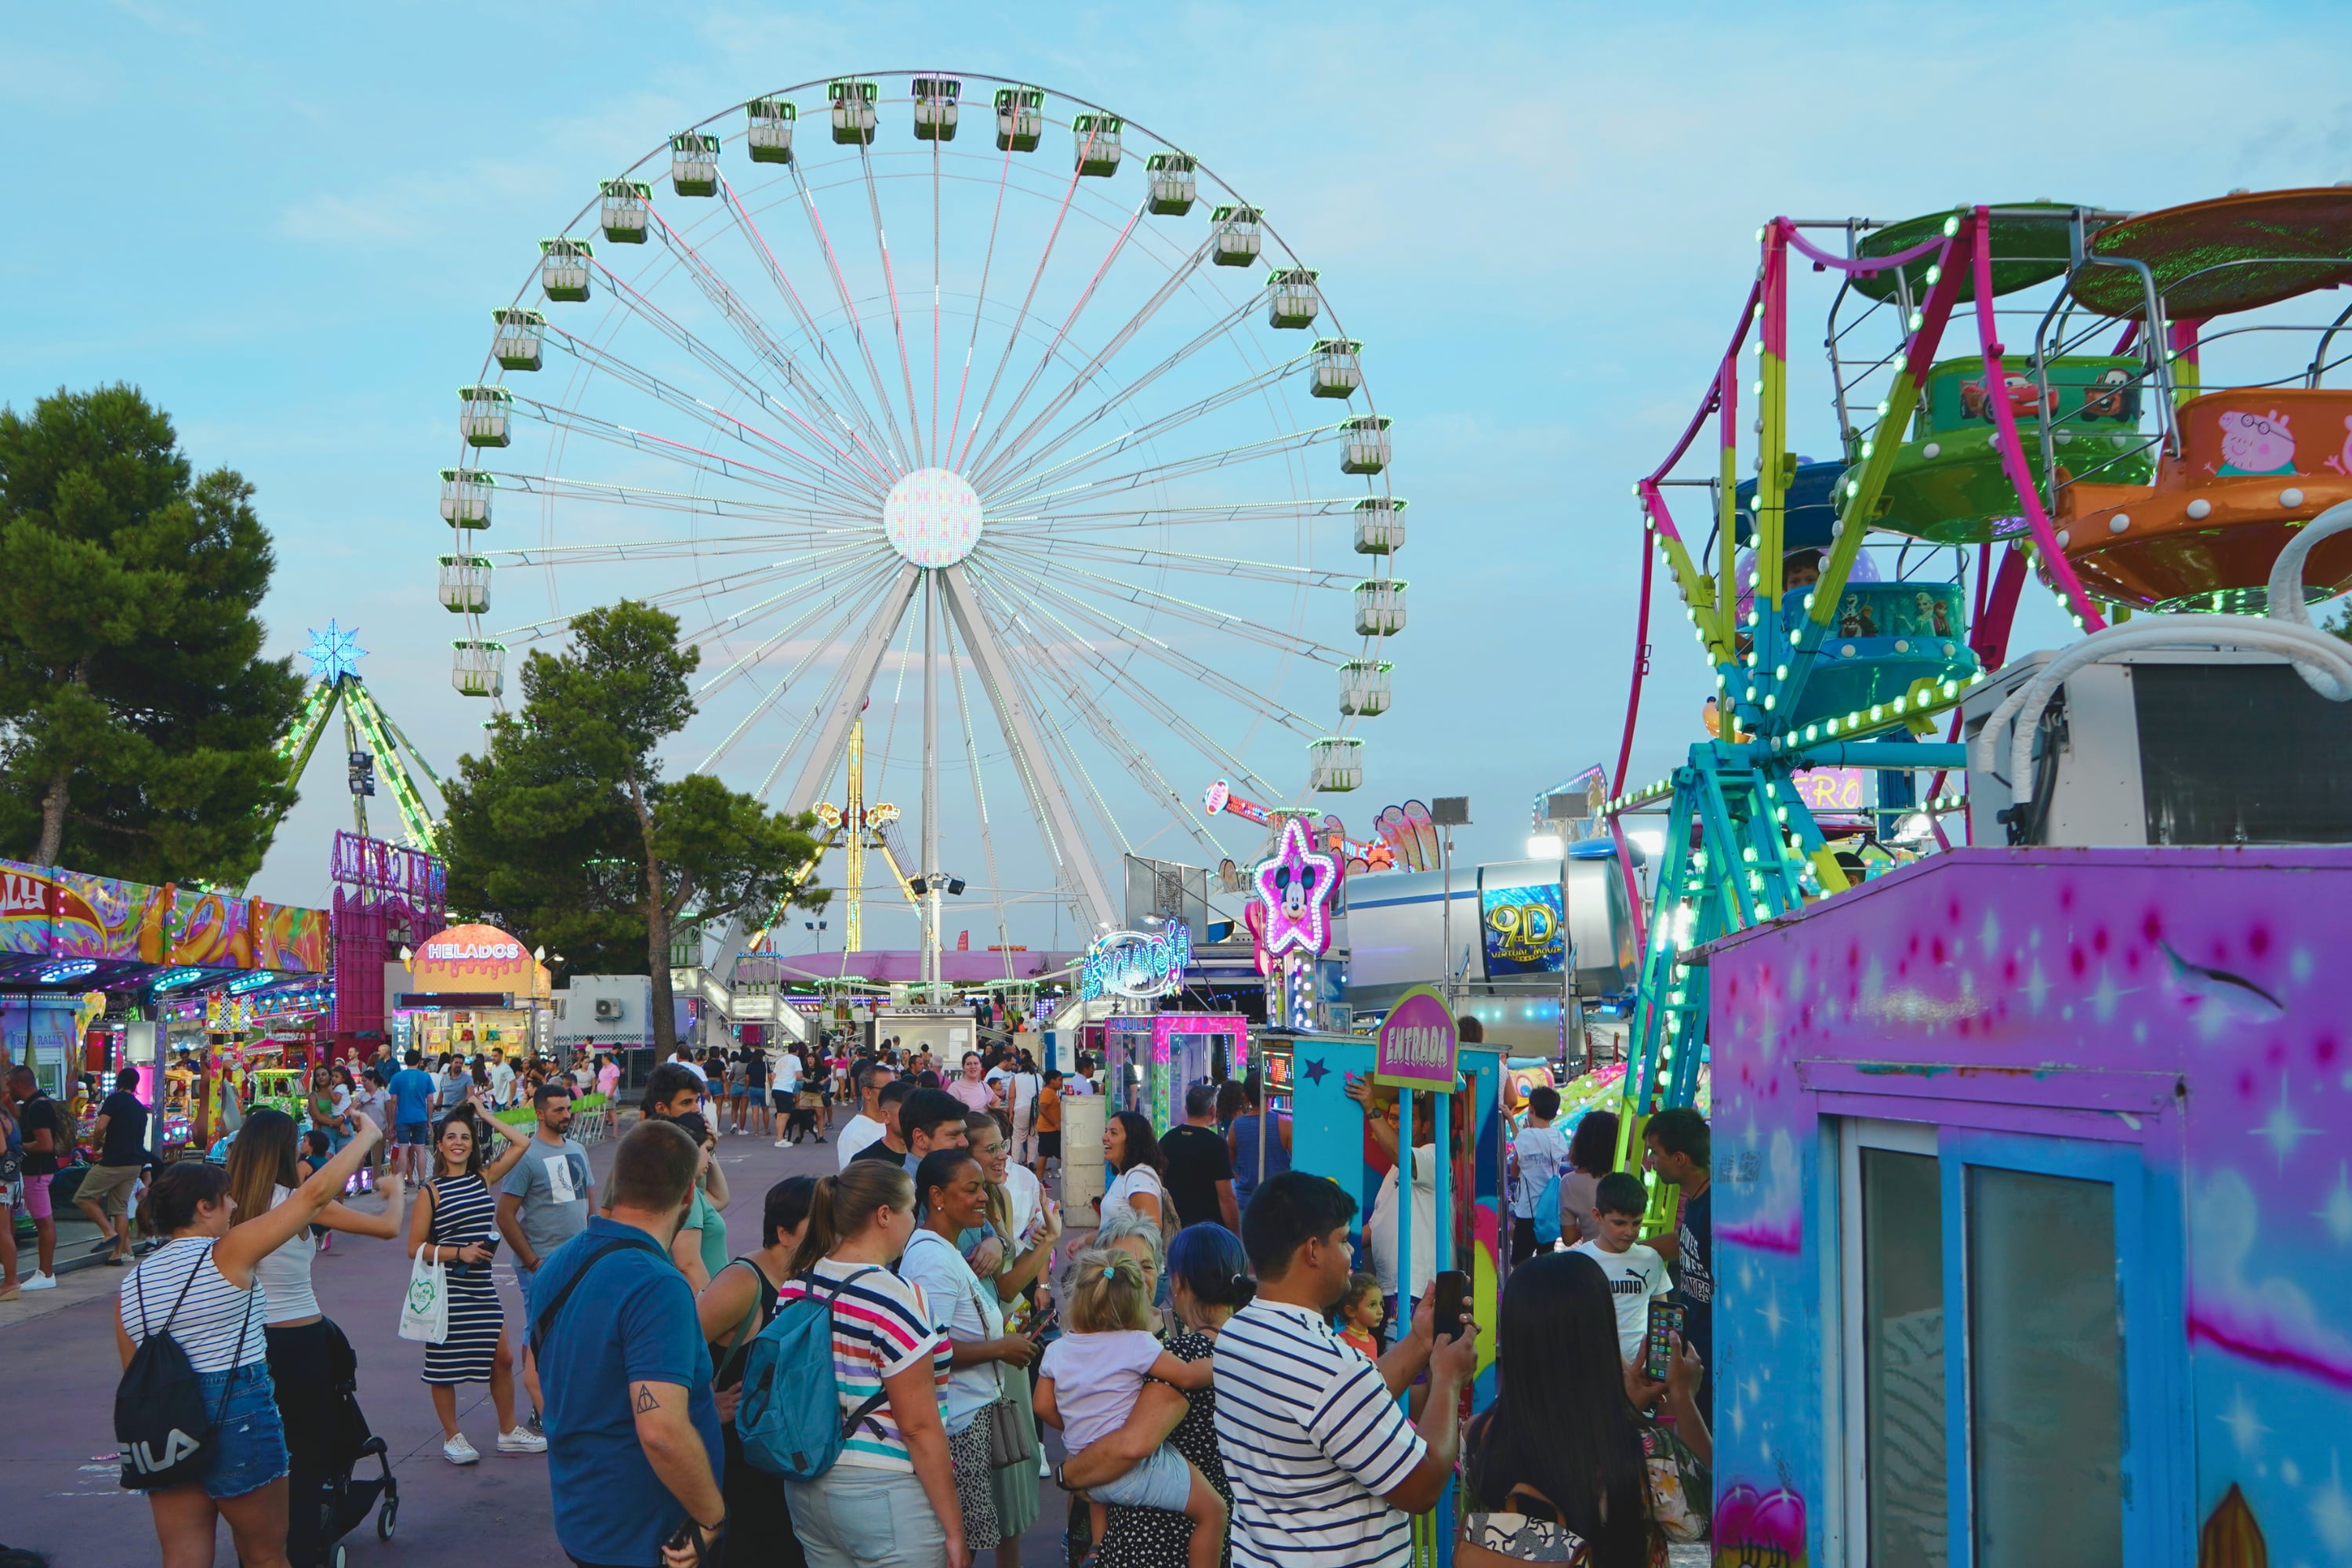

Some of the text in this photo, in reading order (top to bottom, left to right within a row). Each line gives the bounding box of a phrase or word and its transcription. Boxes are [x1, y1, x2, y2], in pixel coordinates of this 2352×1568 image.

[1486, 903, 1558, 947] 9D
[428, 942, 518, 959] HELADOS
[1491, 948, 1528, 958] VIRTUAL
[1110, 1018, 1153, 1030] TAQUILLA
[38, 1035, 62, 1045] RALLY
[1386, 1025, 1448, 1068] ENTRADA
[1610, 1280, 1642, 1294] UMA
[118, 1428, 200, 1474] FILA
